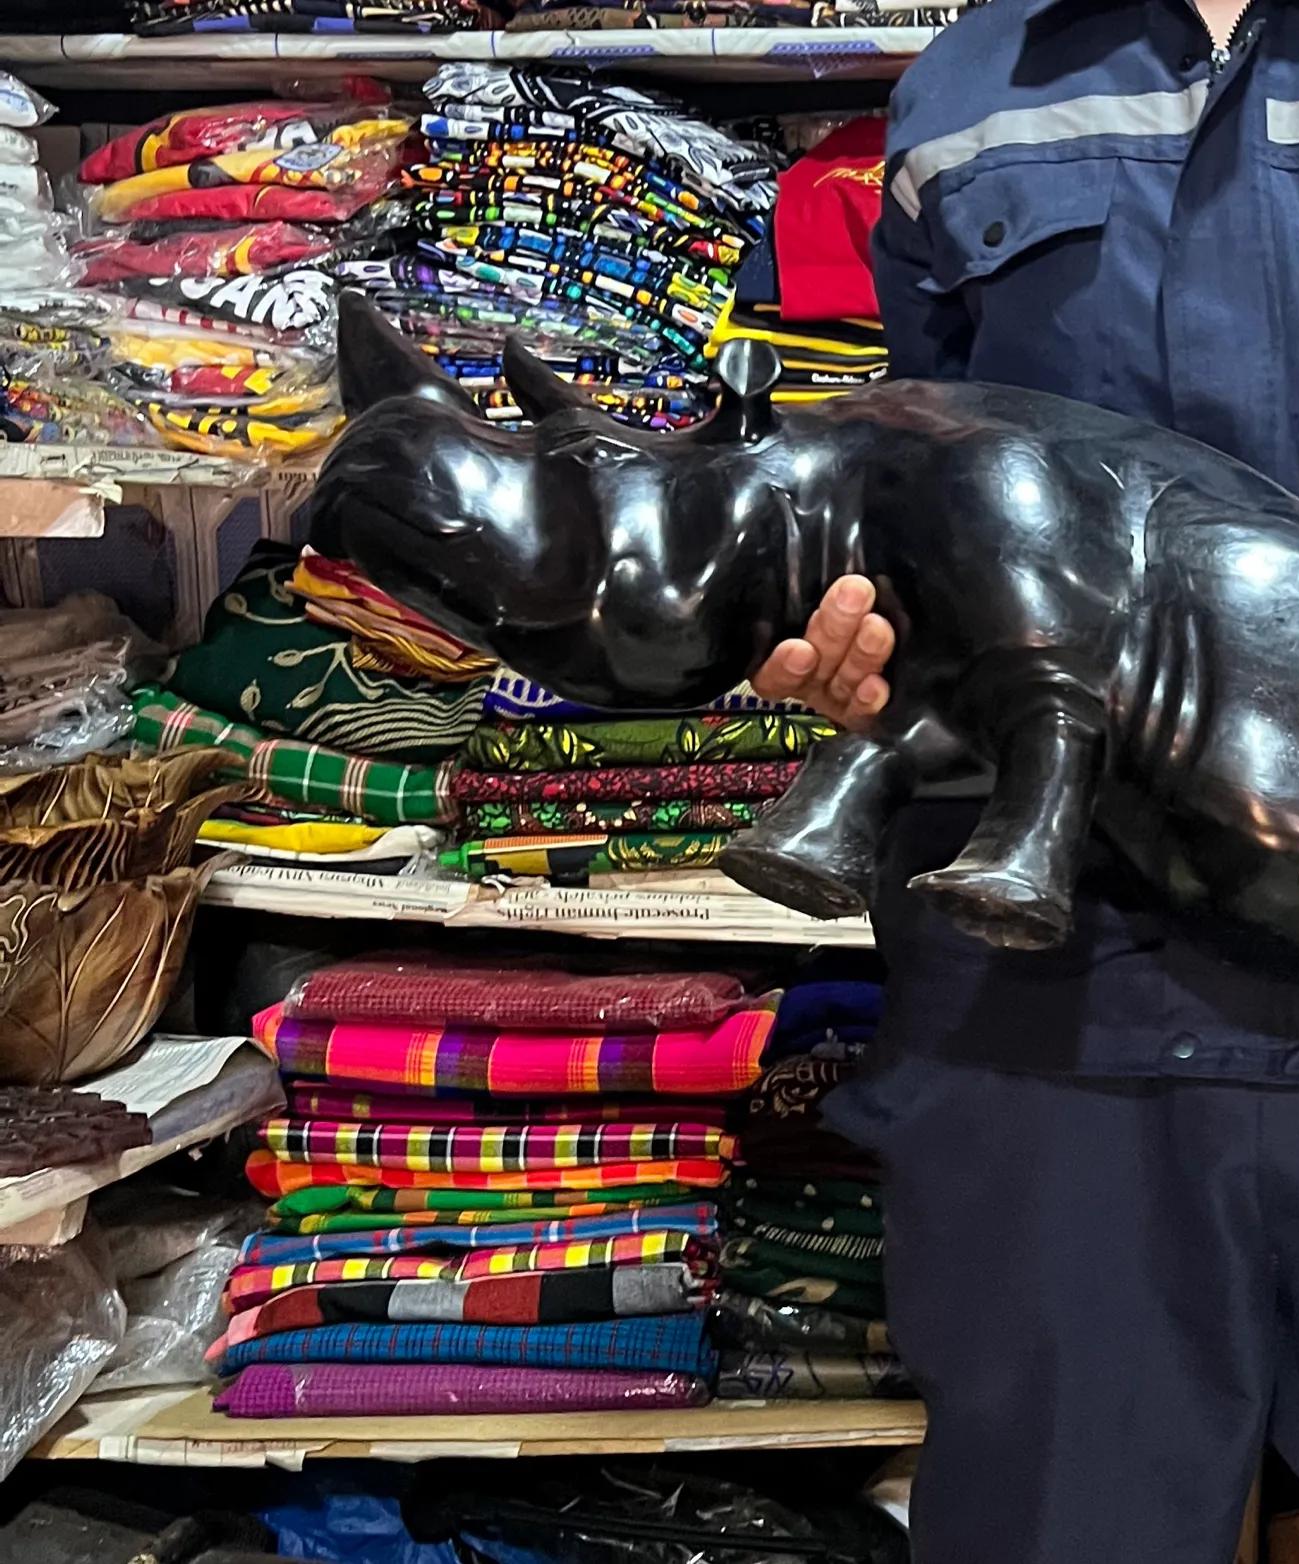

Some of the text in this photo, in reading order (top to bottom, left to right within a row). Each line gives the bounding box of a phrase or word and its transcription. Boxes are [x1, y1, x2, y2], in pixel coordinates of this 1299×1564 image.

[498, 904, 710, 922] Prosecute human rights
